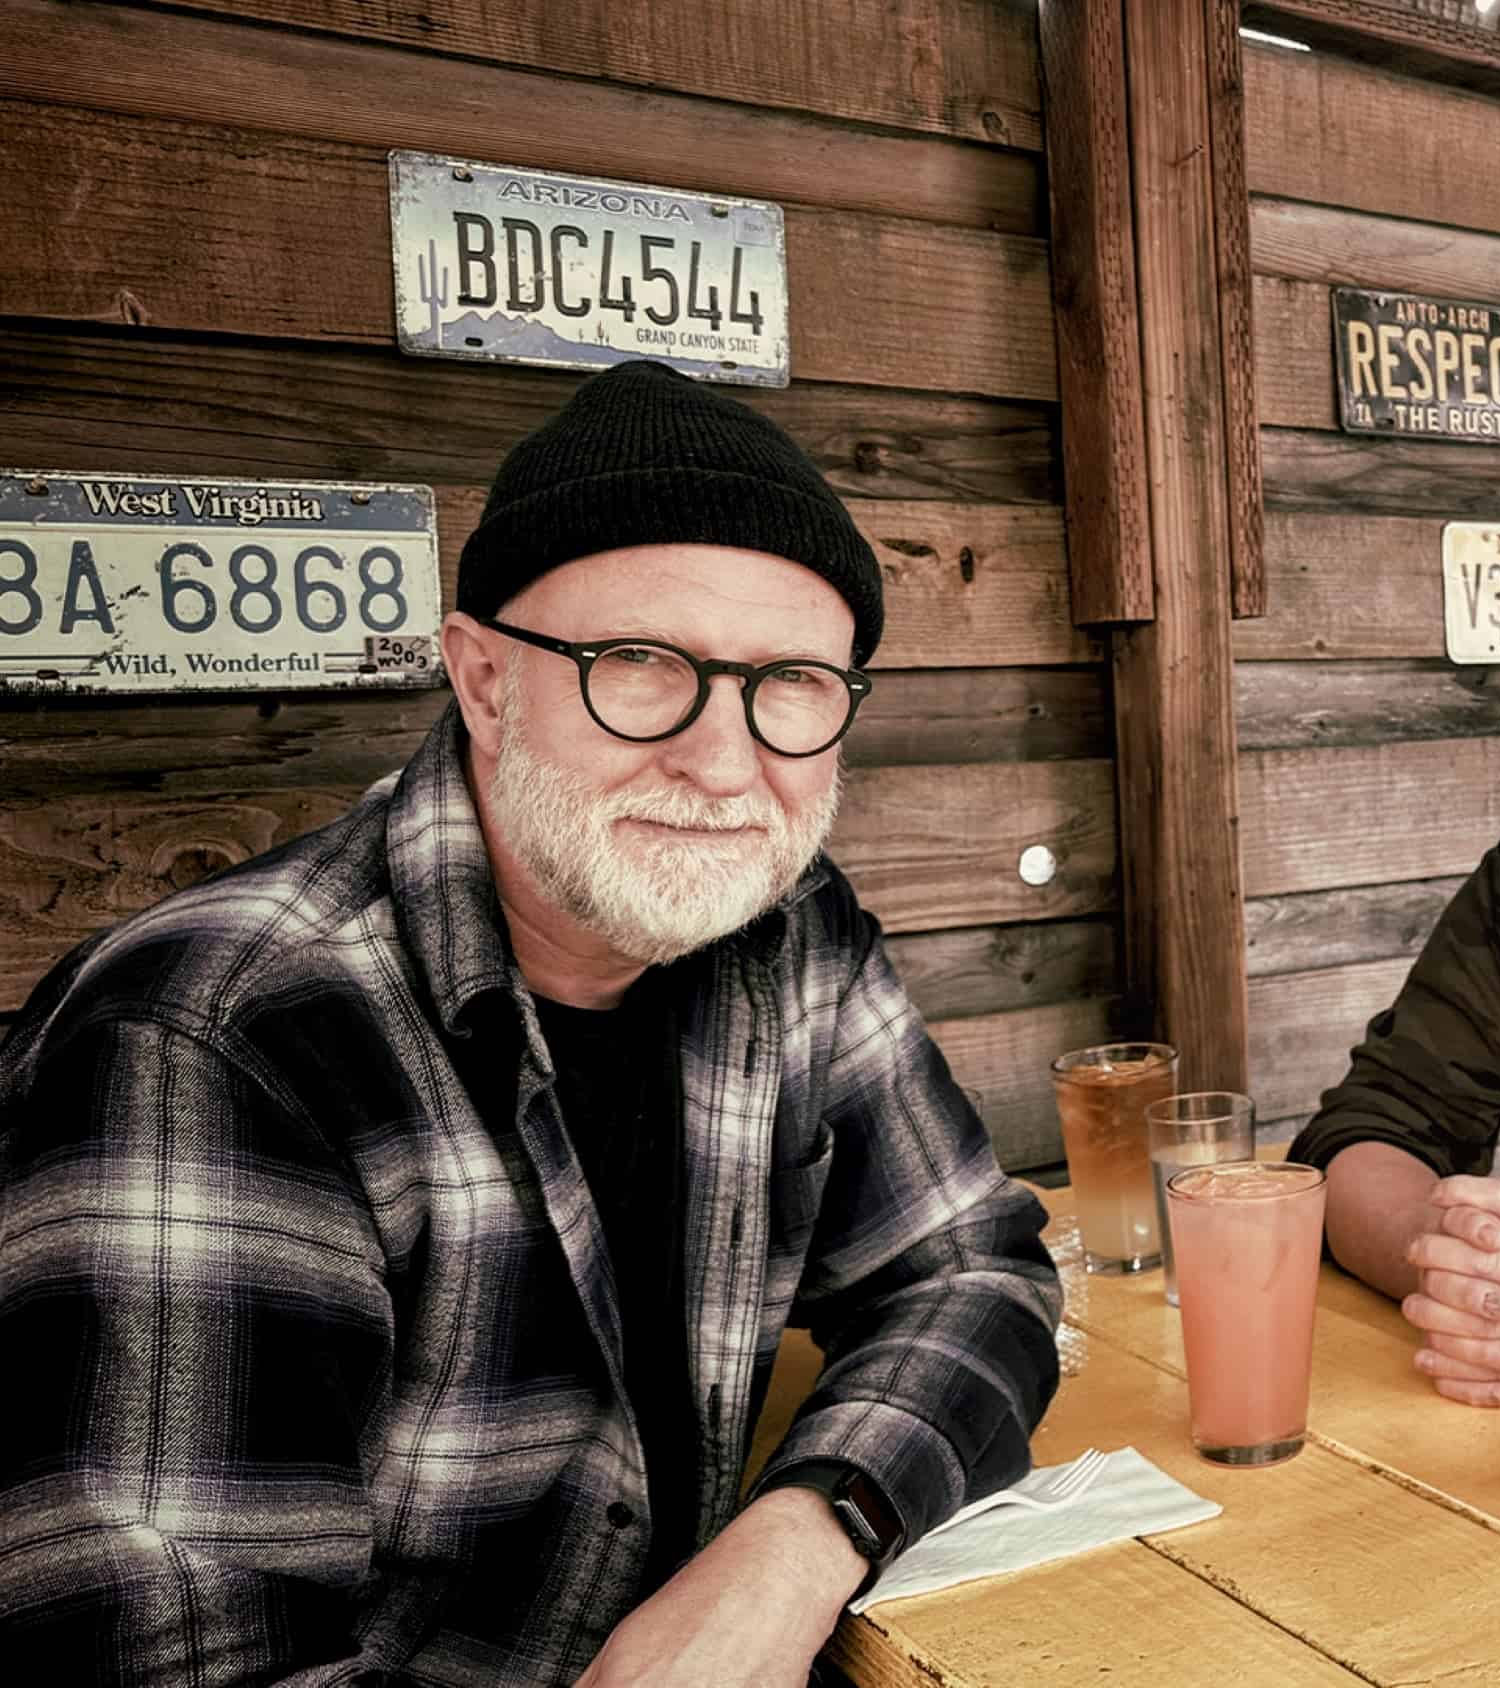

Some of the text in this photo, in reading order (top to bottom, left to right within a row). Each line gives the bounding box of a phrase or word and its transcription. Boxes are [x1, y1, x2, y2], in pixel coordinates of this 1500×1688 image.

[501, 181, 690, 224] ARIZONA
[453, 211, 764, 335] BDC4544
[636, 327, 760, 354] GRAND CANYON STATE
[1394, 404, 1440, 432] THE
[80, 481, 322, 525] West Virginia
[160, 542, 408, 635] 6868
[104, 651, 320, 677] Wild, Wonderful
